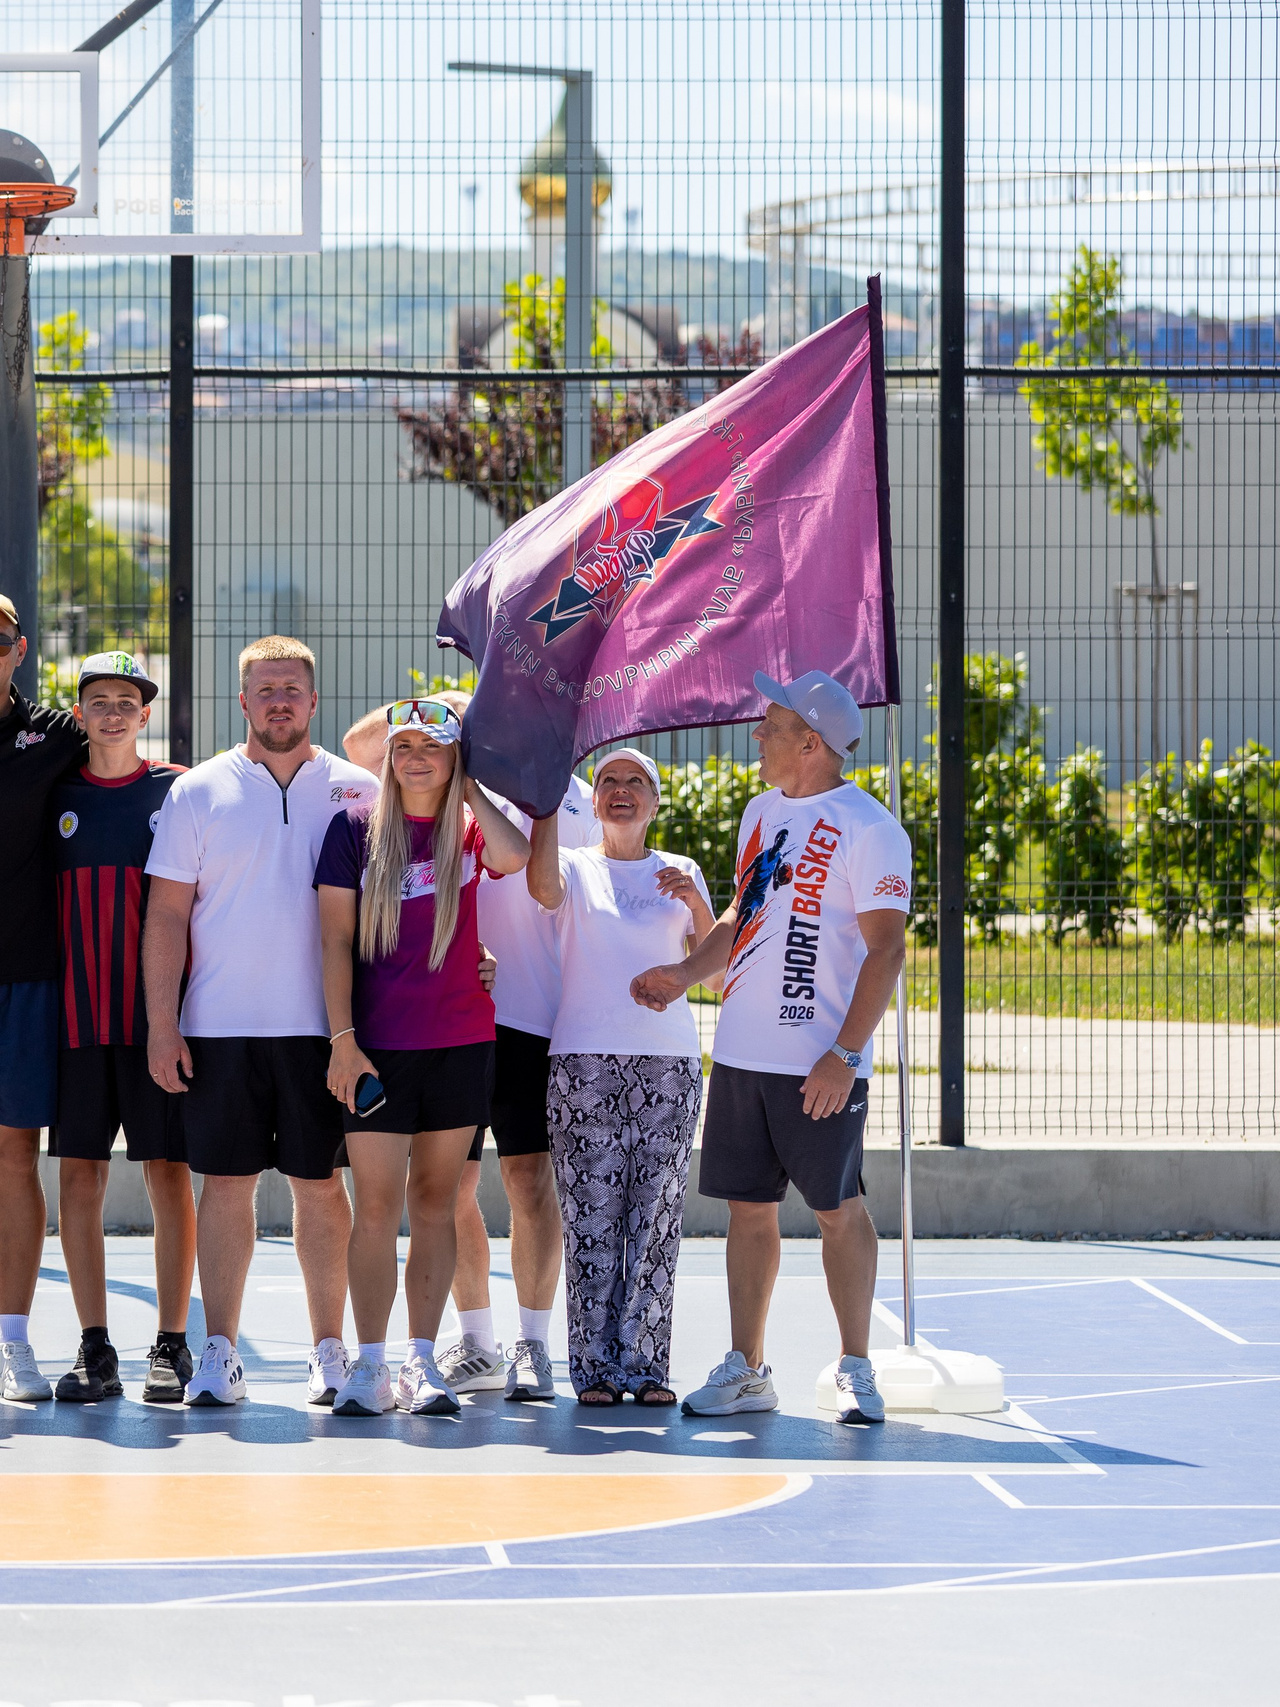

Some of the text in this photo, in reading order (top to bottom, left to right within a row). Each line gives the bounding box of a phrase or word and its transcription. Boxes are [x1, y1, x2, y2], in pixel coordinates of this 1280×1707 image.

[15, 730, 46, 750] Рубин
[330, 786, 361, 803] Рубин
[781, 817, 843, 1001] SHORT BASKET
[779, 1004, 815, 1020] 2026
